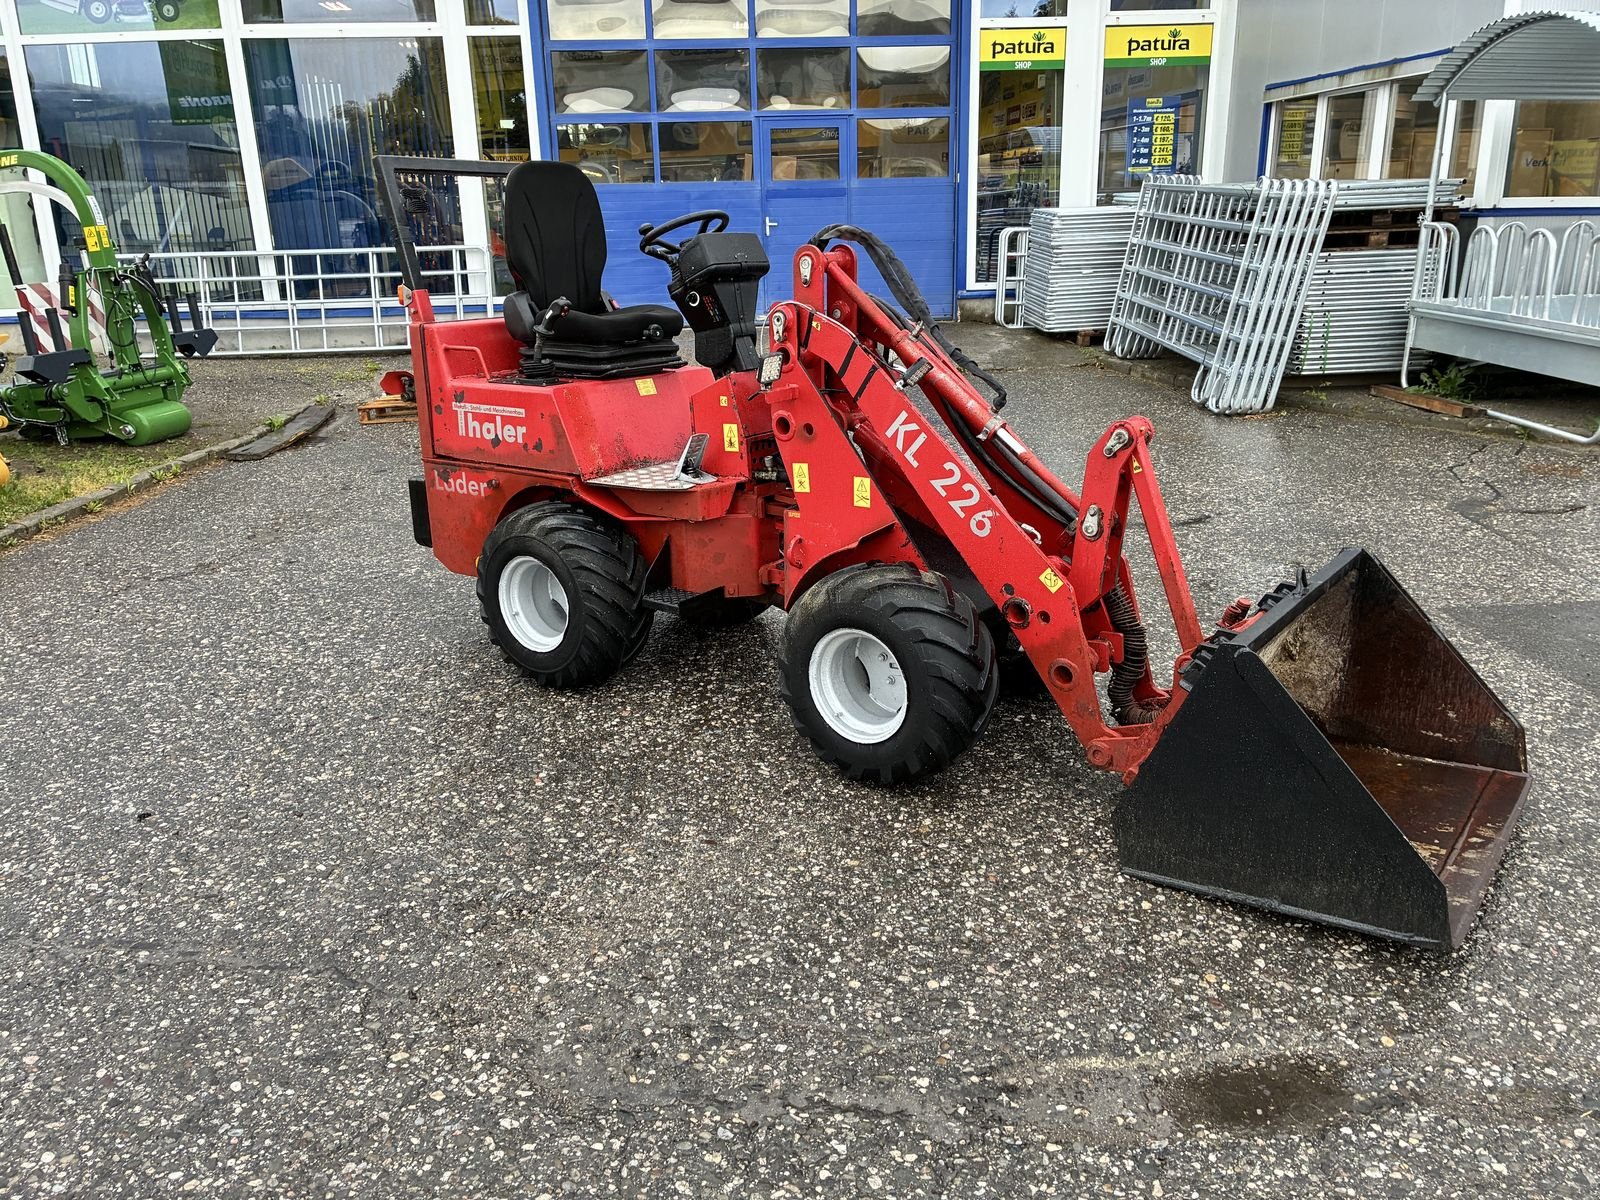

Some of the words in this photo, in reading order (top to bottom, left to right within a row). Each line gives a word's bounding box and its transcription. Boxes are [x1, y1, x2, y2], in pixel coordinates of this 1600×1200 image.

[991, 39, 1055, 59] patura
[1127, 37, 1190, 56] patura
[1014, 60, 1032, 69] SHOP
[1149, 57, 1167, 66] SHOP
[457, 408, 526, 443] Thaler
[433, 469, 488, 497] Lader
[885, 409, 928, 469] KL
[929, 461, 1000, 537] 226
